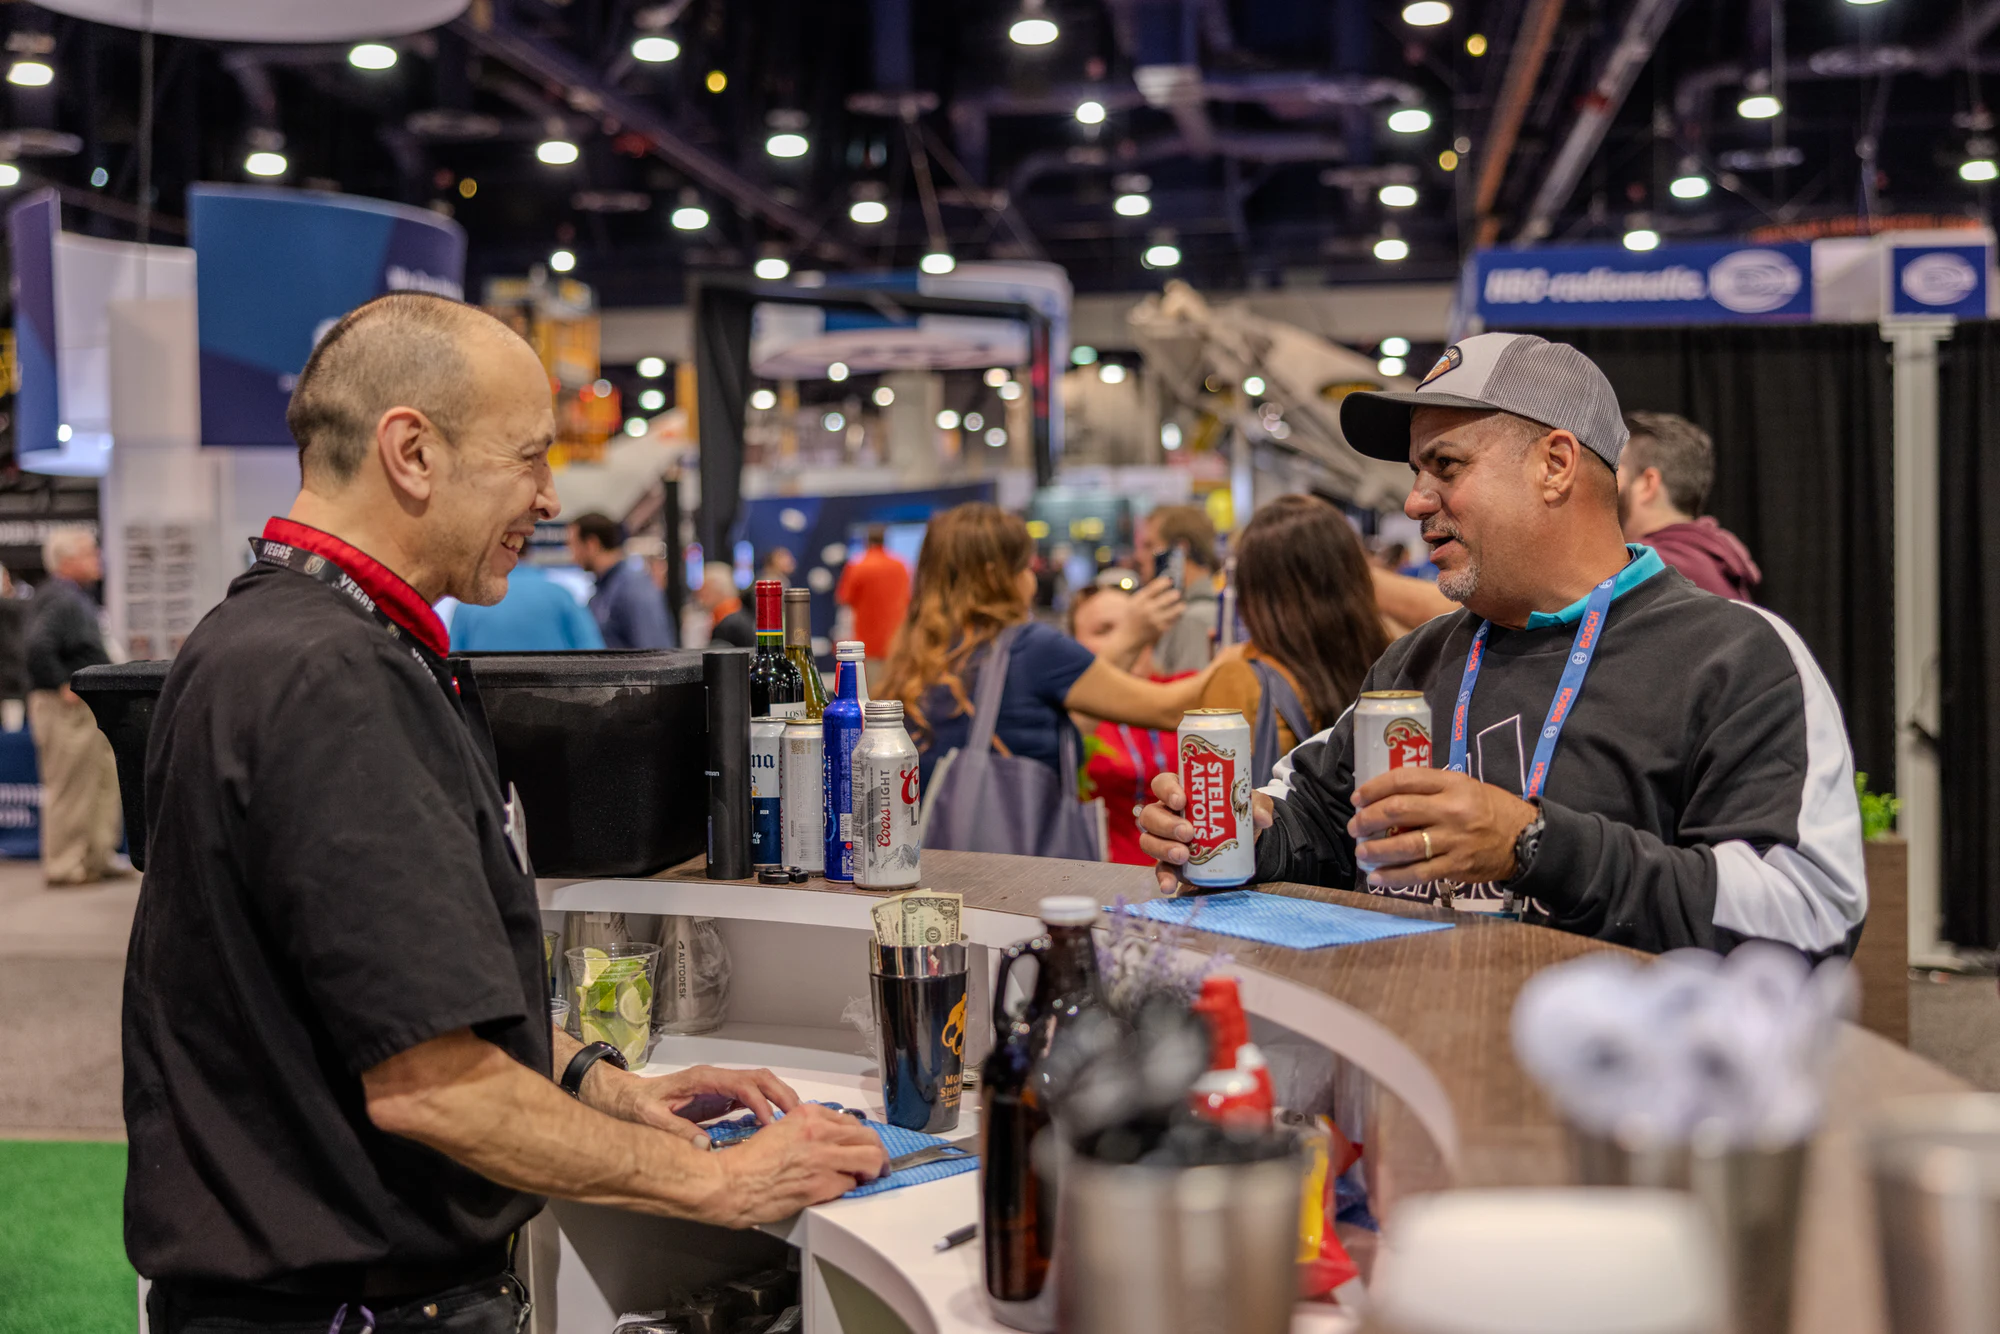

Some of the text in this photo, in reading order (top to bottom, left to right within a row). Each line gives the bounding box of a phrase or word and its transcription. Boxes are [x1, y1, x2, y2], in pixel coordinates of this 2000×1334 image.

[263, 541, 293, 561] VEGAS
[340, 573, 376, 612] VEGAS
[1578, 611, 1600, 649] BOSCH
[1468, 640, 1483, 672] BOSCH
[1454, 704, 1465, 742] BOSCH
[1551, 687, 1573, 722] BOSCH
[876, 770, 891, 847] Coors LIGHT
[1191, 760, 1207, 840] ARTOIS
[1207, 762, 1225, 840] STELLA
[678, 952, 686, 1000] AUTODESK
